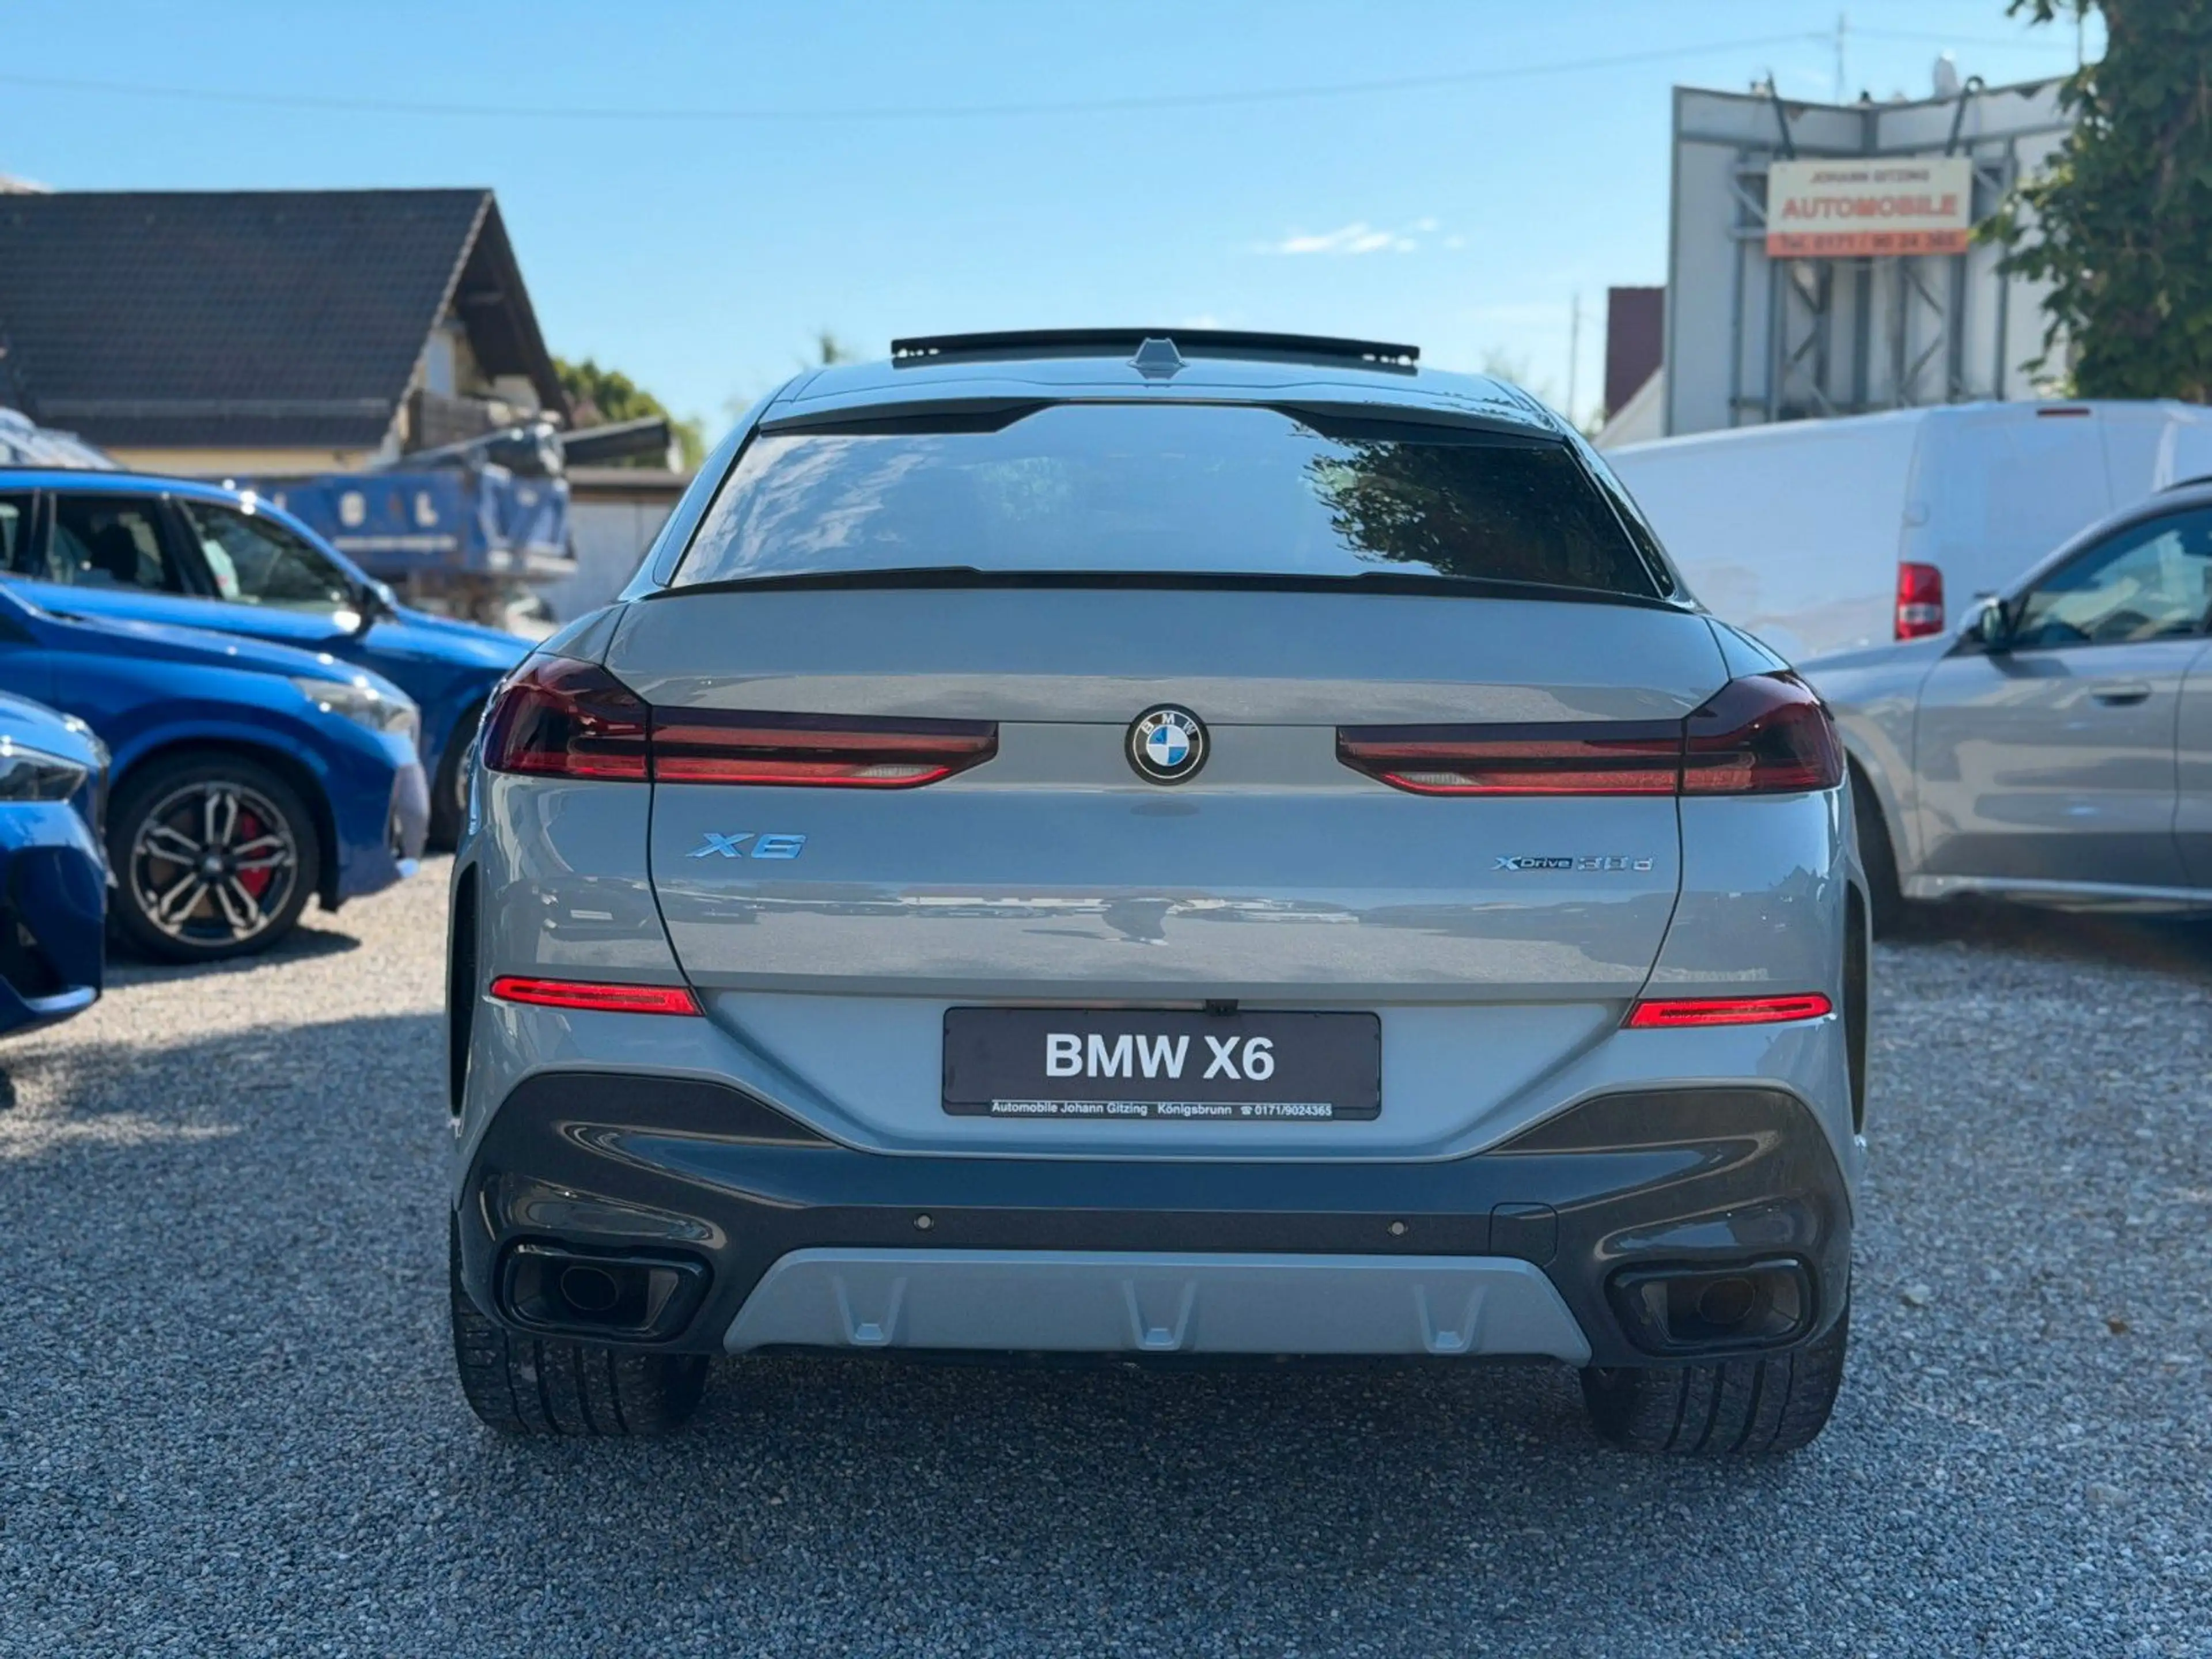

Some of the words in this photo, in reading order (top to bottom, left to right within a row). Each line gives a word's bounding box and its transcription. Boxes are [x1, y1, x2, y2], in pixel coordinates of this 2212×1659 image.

[1782, 193, 1957, 218] AUTOMOBILE
[1141, 713, 1197, 736] BMW
[685, 832, 806, 859] X6
[1046, 1033, 1189, 1078] BMW
[1202, 1036, 1275, 1081] X6
[992, 1101, 1058, 1113] Automobile
[1060, 1102, 1103, 1113] Johann
[1106, 1103, 1149, 1116] Gitzing
[1157, 1103, 1232, 1117] Königsbrunn
